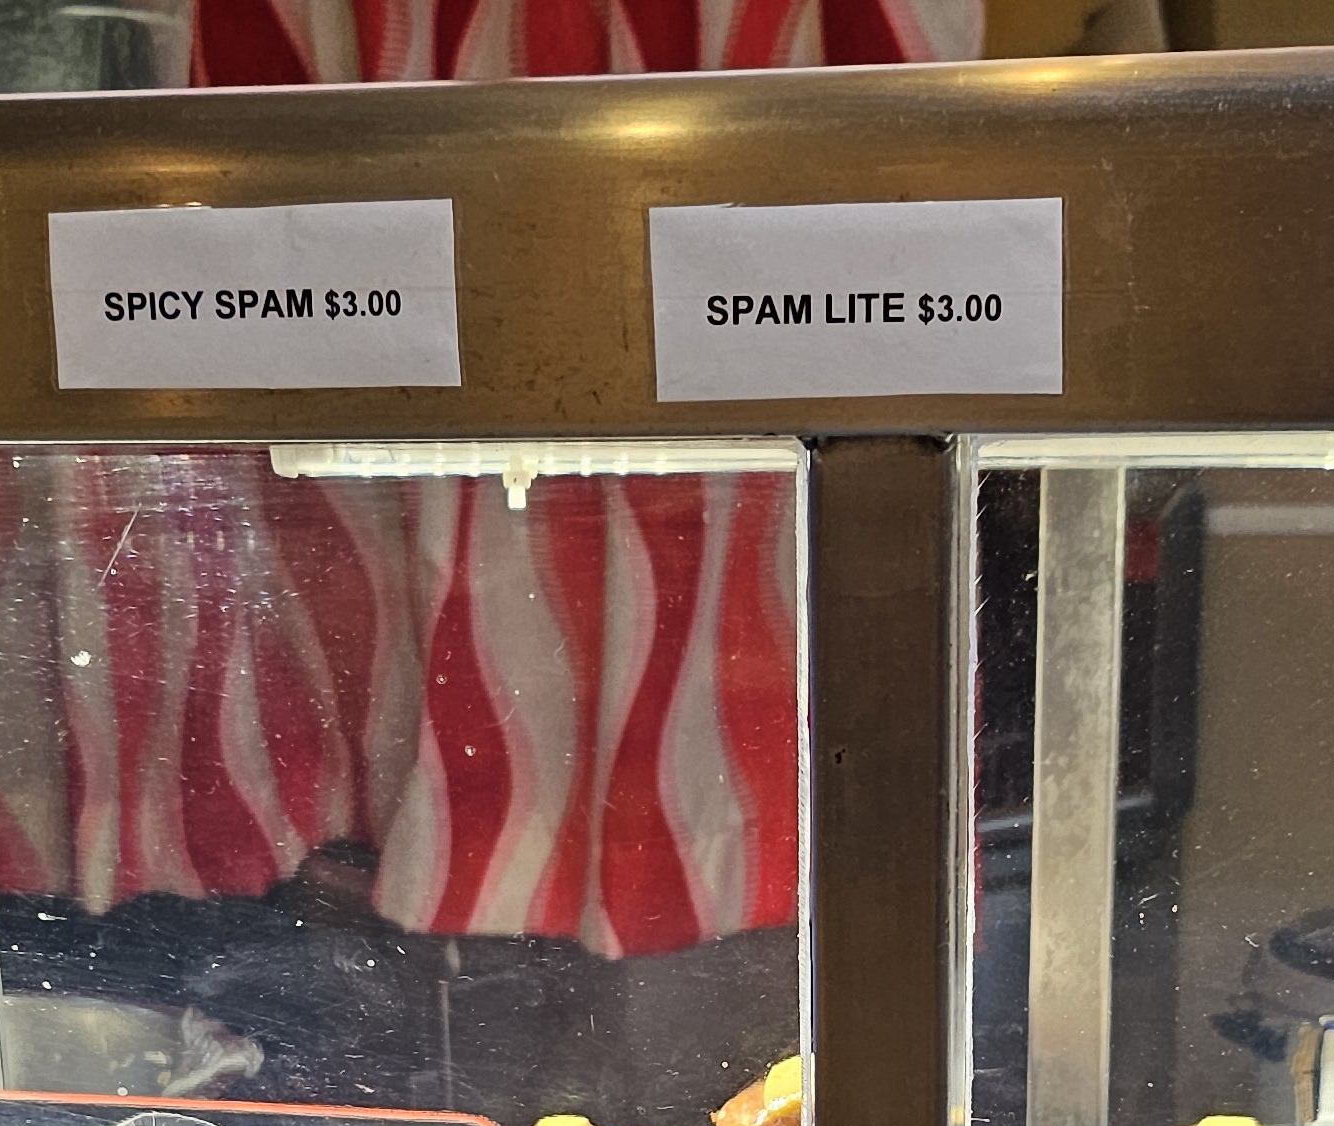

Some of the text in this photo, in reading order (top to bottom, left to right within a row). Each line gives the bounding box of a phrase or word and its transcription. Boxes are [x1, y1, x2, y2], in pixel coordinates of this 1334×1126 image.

[104, 288, 402, 322] SPICY SPAM $3.00
[706, 292, 1002, 326] SPAM LITE $3.00
